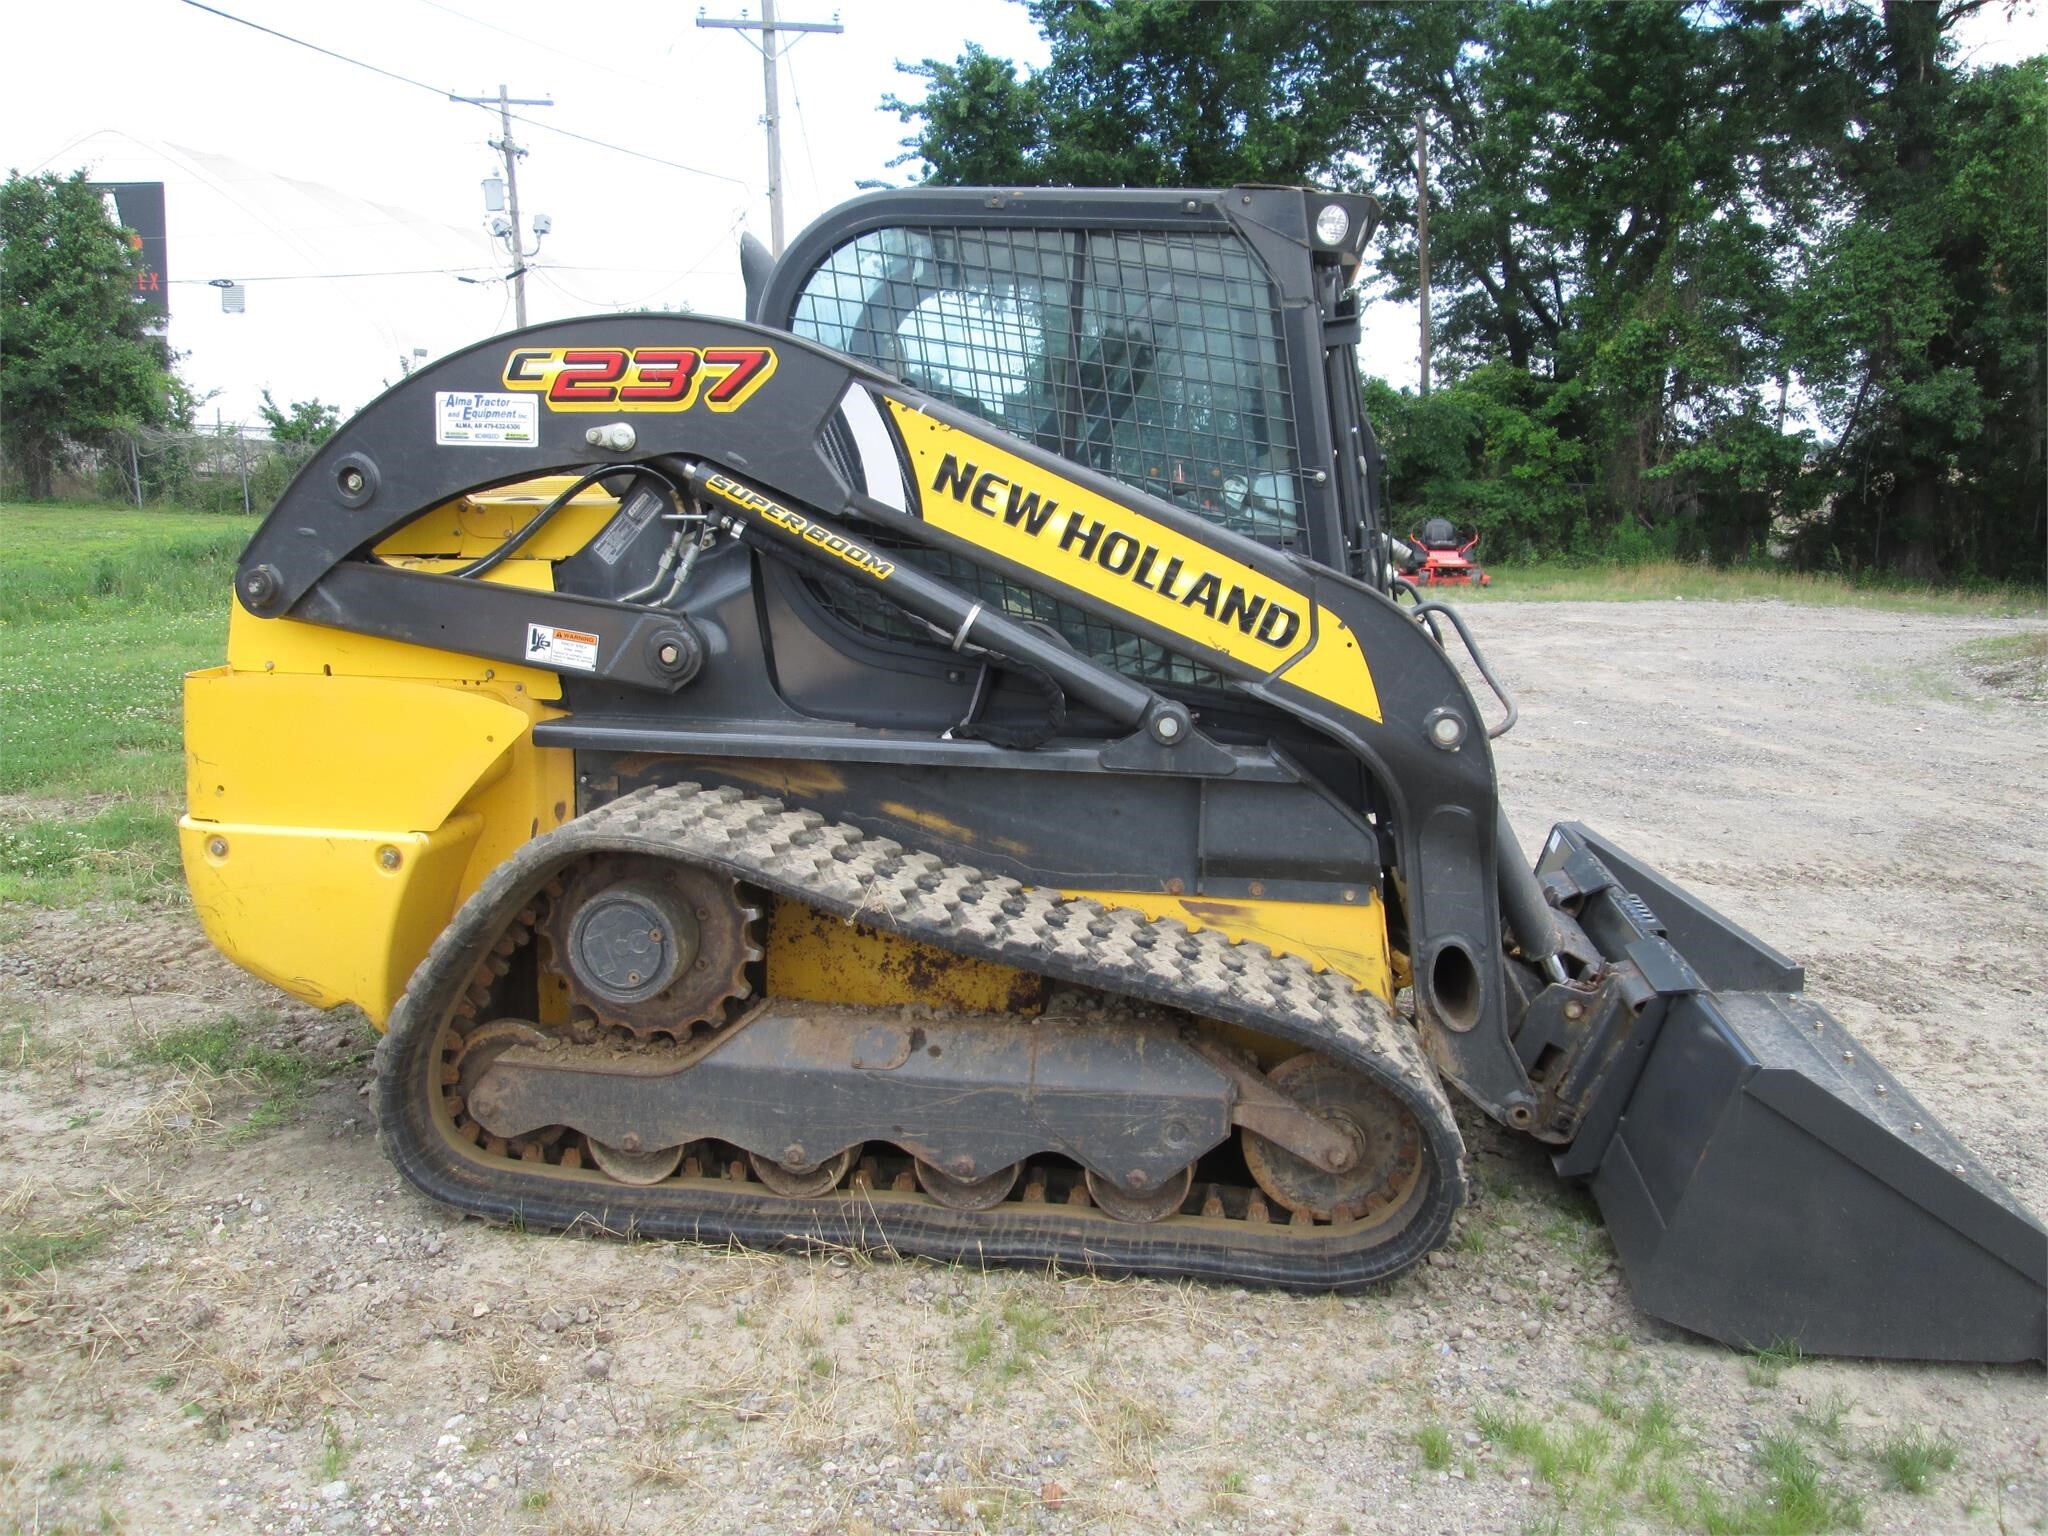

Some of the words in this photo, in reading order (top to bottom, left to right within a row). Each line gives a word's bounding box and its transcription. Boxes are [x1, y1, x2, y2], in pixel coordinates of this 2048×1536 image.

[502, 346, 778, 412] C237
[445, 394, 472, 408] Alma
[474, 394, 511, 408] Tractor
[463, 406, 516, 420] Equipment
[931, 453, 1059, 537] NEW
[1058, 510, 1301, 650] HOLLAND
[563, 632, 595, 643] WARNING
